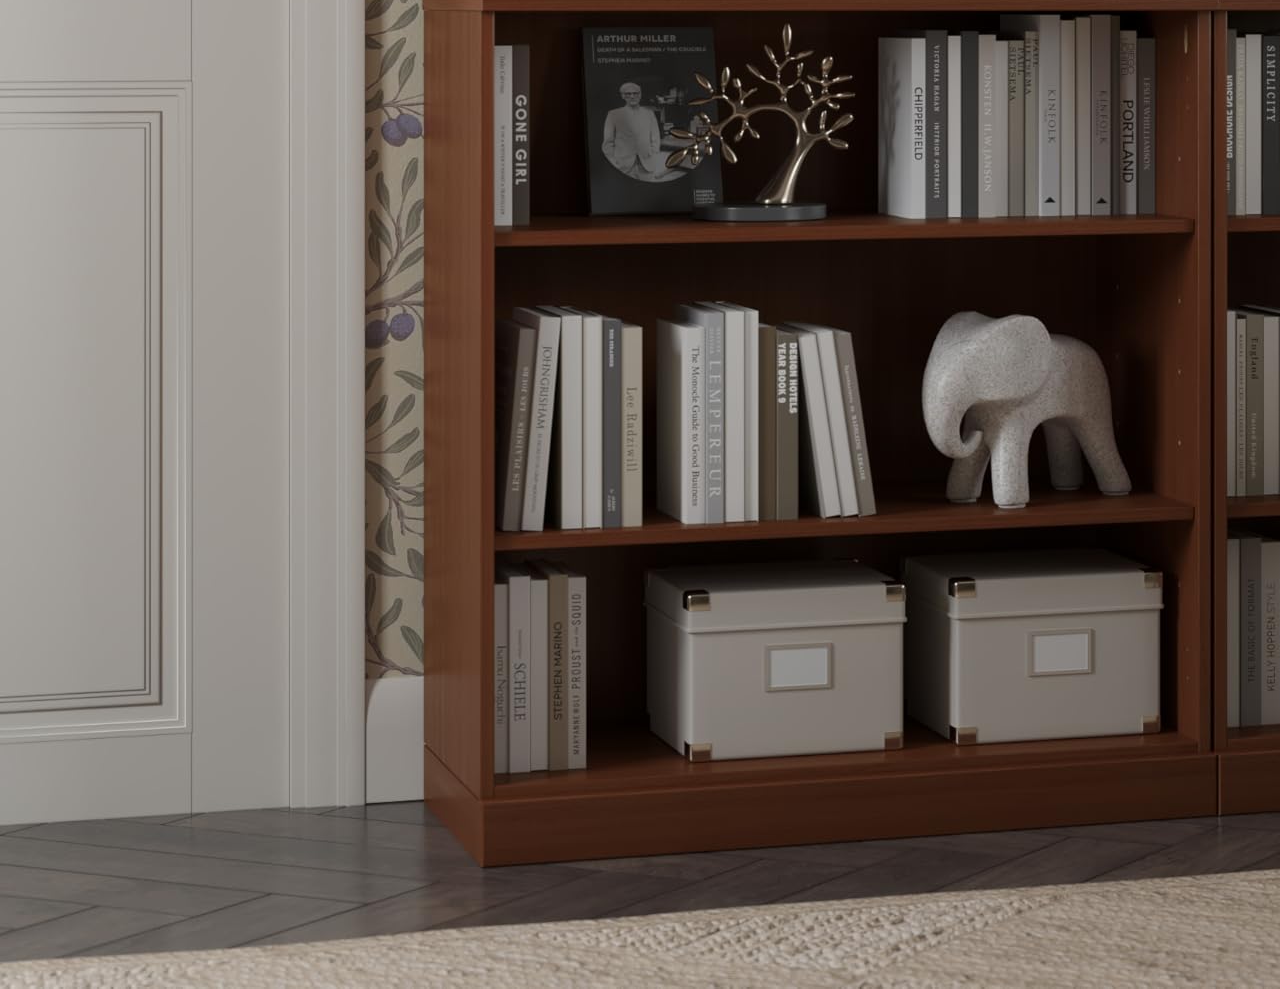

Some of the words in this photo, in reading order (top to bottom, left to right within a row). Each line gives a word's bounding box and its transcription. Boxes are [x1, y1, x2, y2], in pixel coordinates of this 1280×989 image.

[597, 34, 639, 43] ARTHUR
[640, 34, 677, 43] MILLER
[933, 45, 941, 82] VICTORIA
[983, 65, 993, 116] KONSTEN
[1266, 45, 1276, 123] SIMPLICITY
[514, 94, 528, 142] GONE
[913, 86, 923, 161] CHIPPERFIELD
[1047, 89, 1058, 144] KINFOLK
[1099, 90, 1109, 145] KINFOLK
[1122, 100, 1135, 183] PORTLAND
[514, 148, 528, 186] GIRL
[692, 347, 700, 363] The
[777, 342, 787, 367] YEAR
[788, 342, 798, 377] DESIGN
[1251, 337, 1260, 380] England
[626, 387, 638, 408] Lee
[692, 366, 700, 403] Monocle
[777, 369, 787, 396] BOOK
[788, 379, 798, 414] HOTELS
[692, 405, 700, 431] Guide
[708, 360, 722, 499] LEMPEREUR
[626, 413, 638, 473] Radziwill
[692, 433, 700, 442] to
[692, 444, 700, 467] Good
[692, 471, 700, 507] Business
[571, 594, 581, 626] SQUID
[553, 622, 563, 667] MARINO
[1266, 616, 1276, 659] HOPPEN
[571, 649, 581, 690] PROUST
[1266, 660, 1276, 692] KELLY
[514, 662, 526, 721] SCHIELE
[553, 671, 563, 721] STEPHEN
